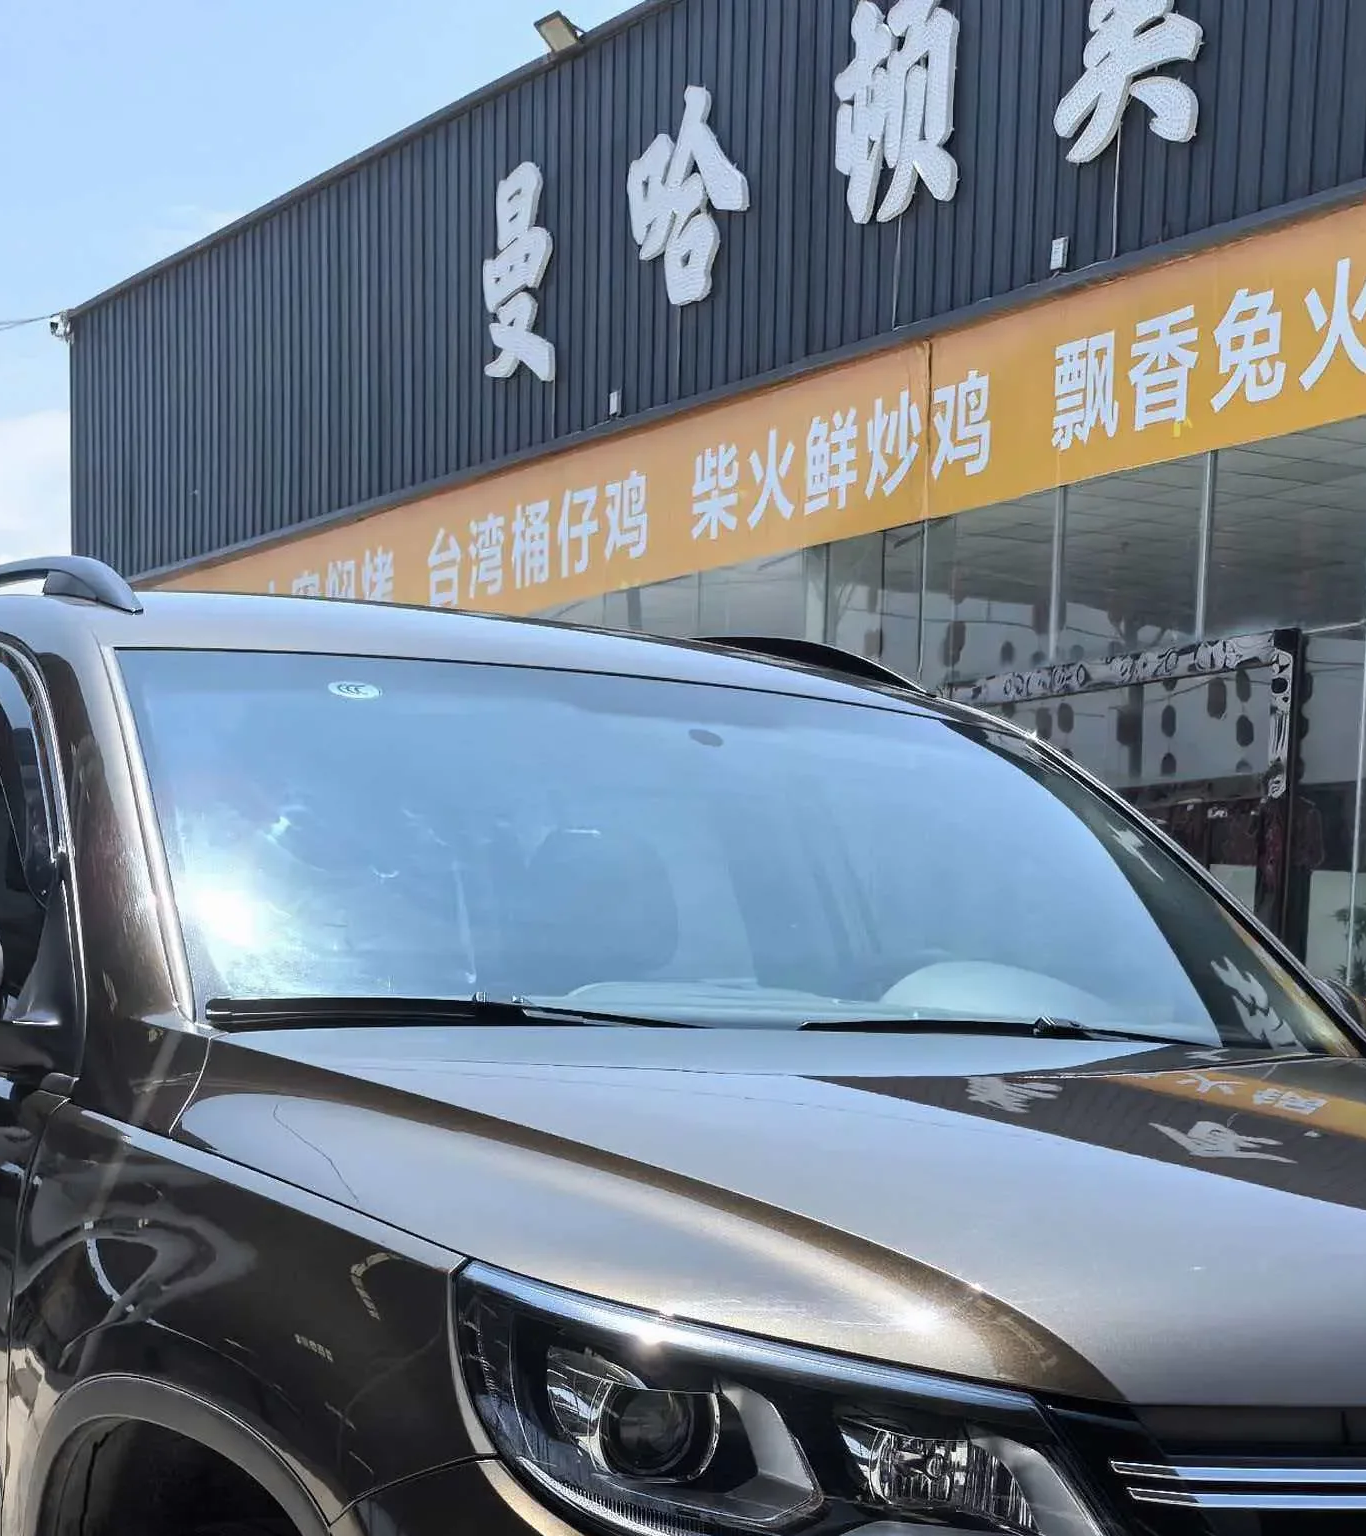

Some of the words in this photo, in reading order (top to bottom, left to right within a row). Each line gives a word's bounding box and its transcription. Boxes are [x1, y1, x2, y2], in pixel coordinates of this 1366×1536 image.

[426, 470, 649, 608] 台湾桶仔鸡
[690, 368, 992, 540] 柴火鲜炒鸡
